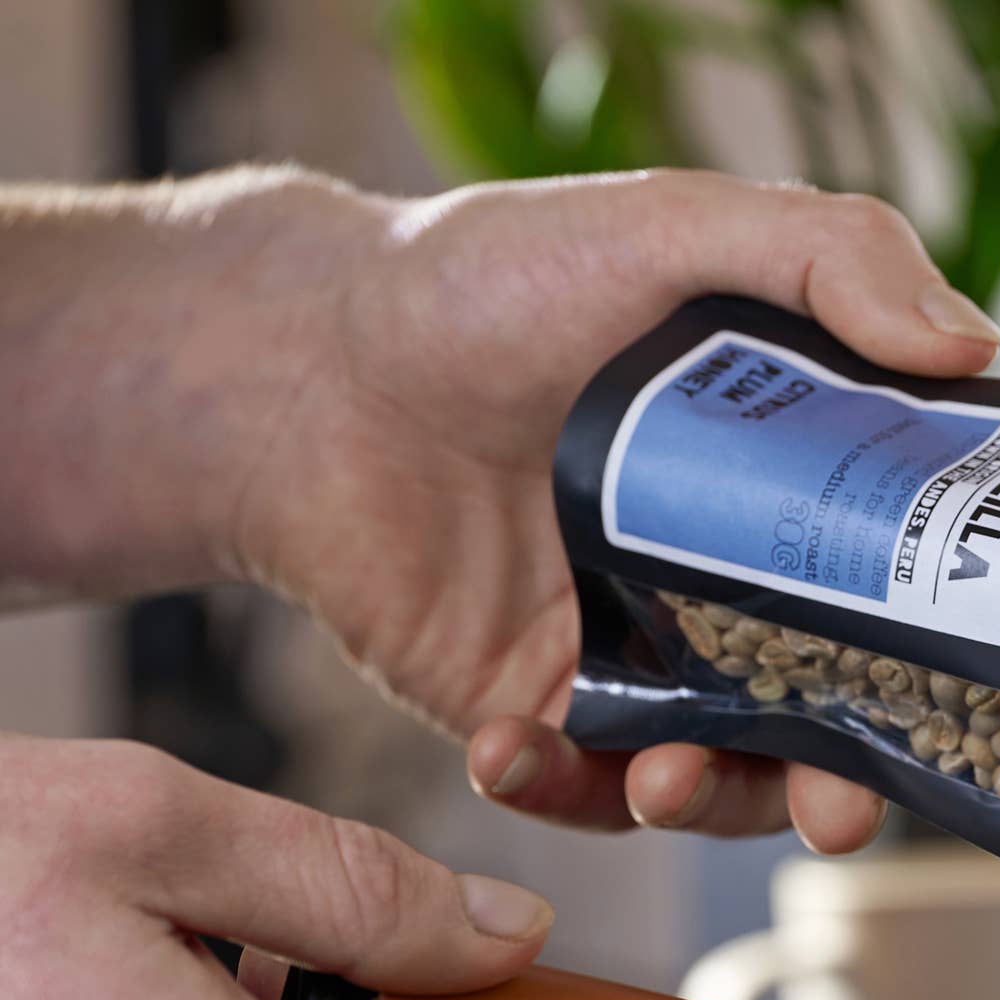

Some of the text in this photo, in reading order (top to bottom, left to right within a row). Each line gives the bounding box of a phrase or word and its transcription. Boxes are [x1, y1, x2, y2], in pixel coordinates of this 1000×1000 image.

[721, 359, 782, 404] PLUM
[816, 448, 863, 520] medium
[862, 490, 886, 521] for
[906, 475, 949, 532] ANDES.
[771, 497, 811, 572] 30G
[805, 524, 824, 580] roast
[847, 524, 874, 585] home
[869, 475, 917, 597] green coffee
[895, 534, 919, 584] PERU
